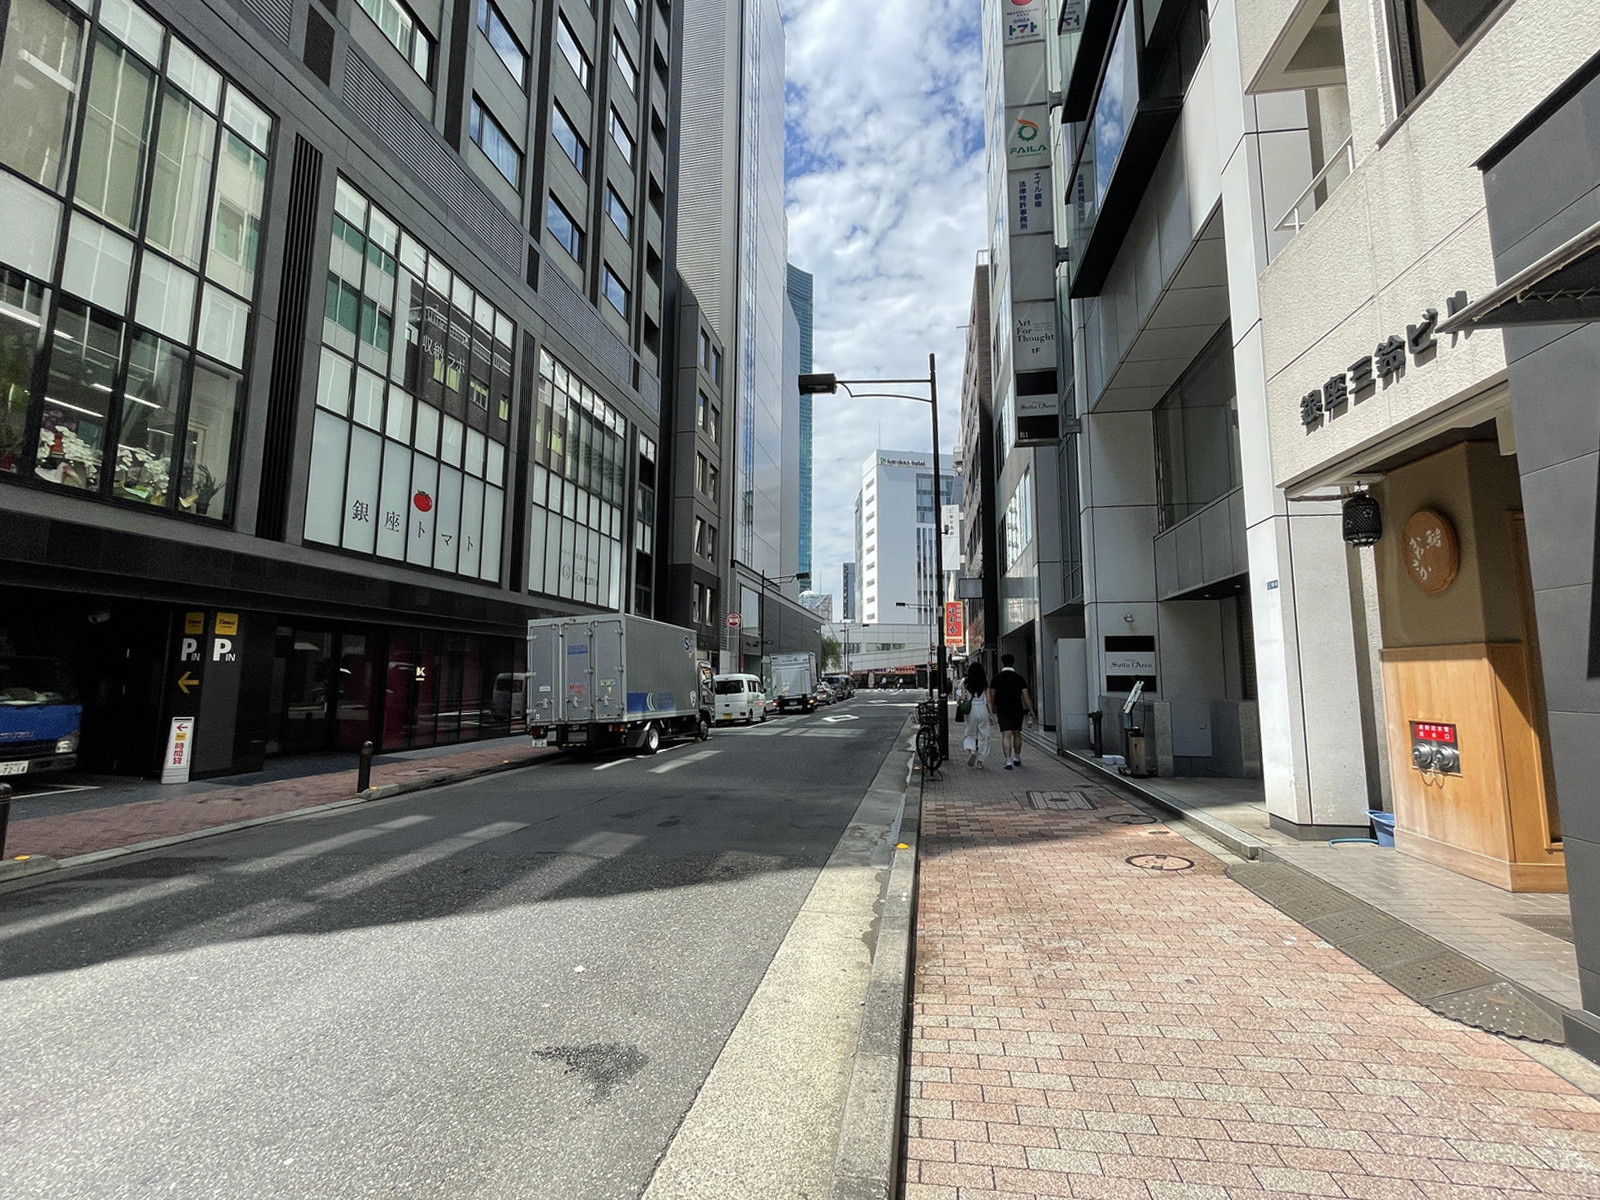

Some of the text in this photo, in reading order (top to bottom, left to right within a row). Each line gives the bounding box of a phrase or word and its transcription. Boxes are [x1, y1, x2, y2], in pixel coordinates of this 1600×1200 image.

[1009, 22, 1038, 36] トマト
[1010, 145, 1047, 155] FAILA
[1016, 320, 1031, 328] Art
[1016, 327, 1033, 335] For
[1016, 333, 1055, 344] Thought
[352, 500, 474, 552] 銀座トマト
[181, 638, 197, 661] P
[213, 638, 236, 661] P IN
